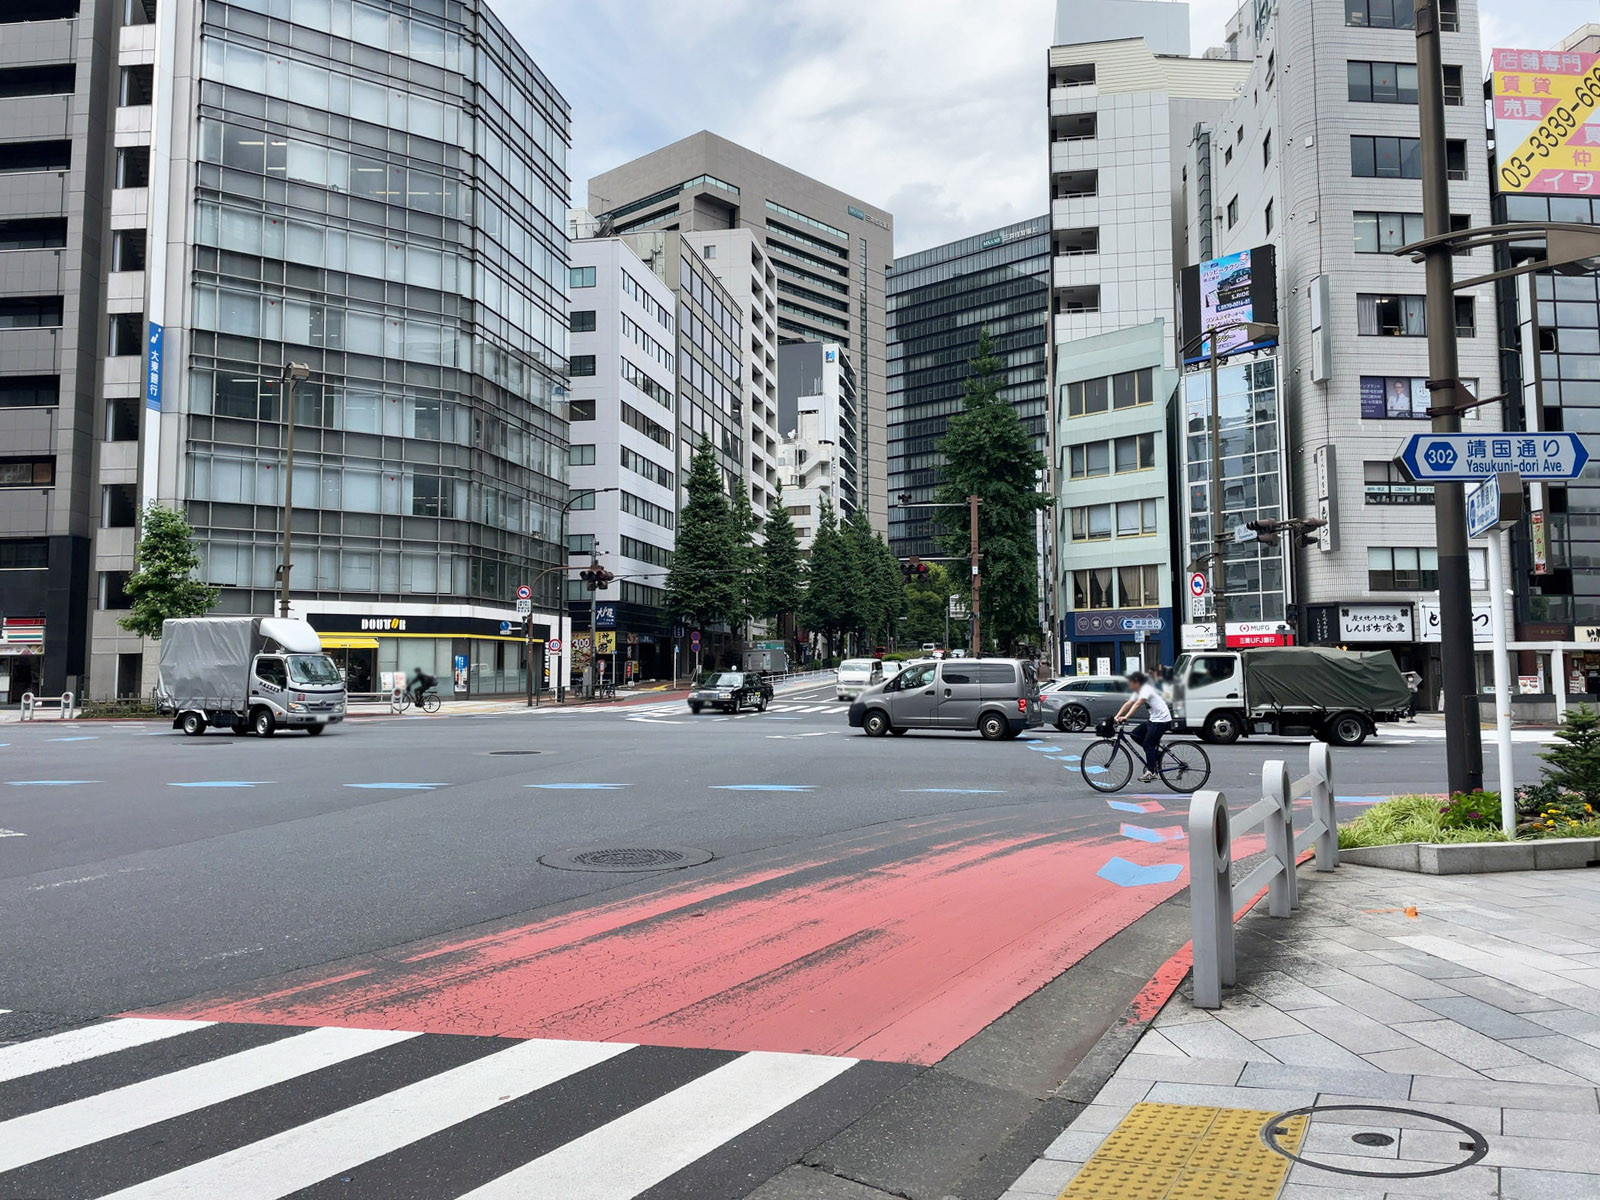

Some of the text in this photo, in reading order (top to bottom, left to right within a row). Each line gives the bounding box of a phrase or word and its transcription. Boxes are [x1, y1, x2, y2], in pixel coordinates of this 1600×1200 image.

[1499, 52, 1582, 73] 店舗専門
[1501, 75, 1552, 96] 賃貸
[1503, 98, 1543, 119] 売買
[1428, 449, 1454, 465] 302
[1467, 439, 1560, 459] 靖国通り
[1466, 459, 1565, 473] Yasukuni-dori Ave.
[361, 618, 406, 631] DOUTOR
